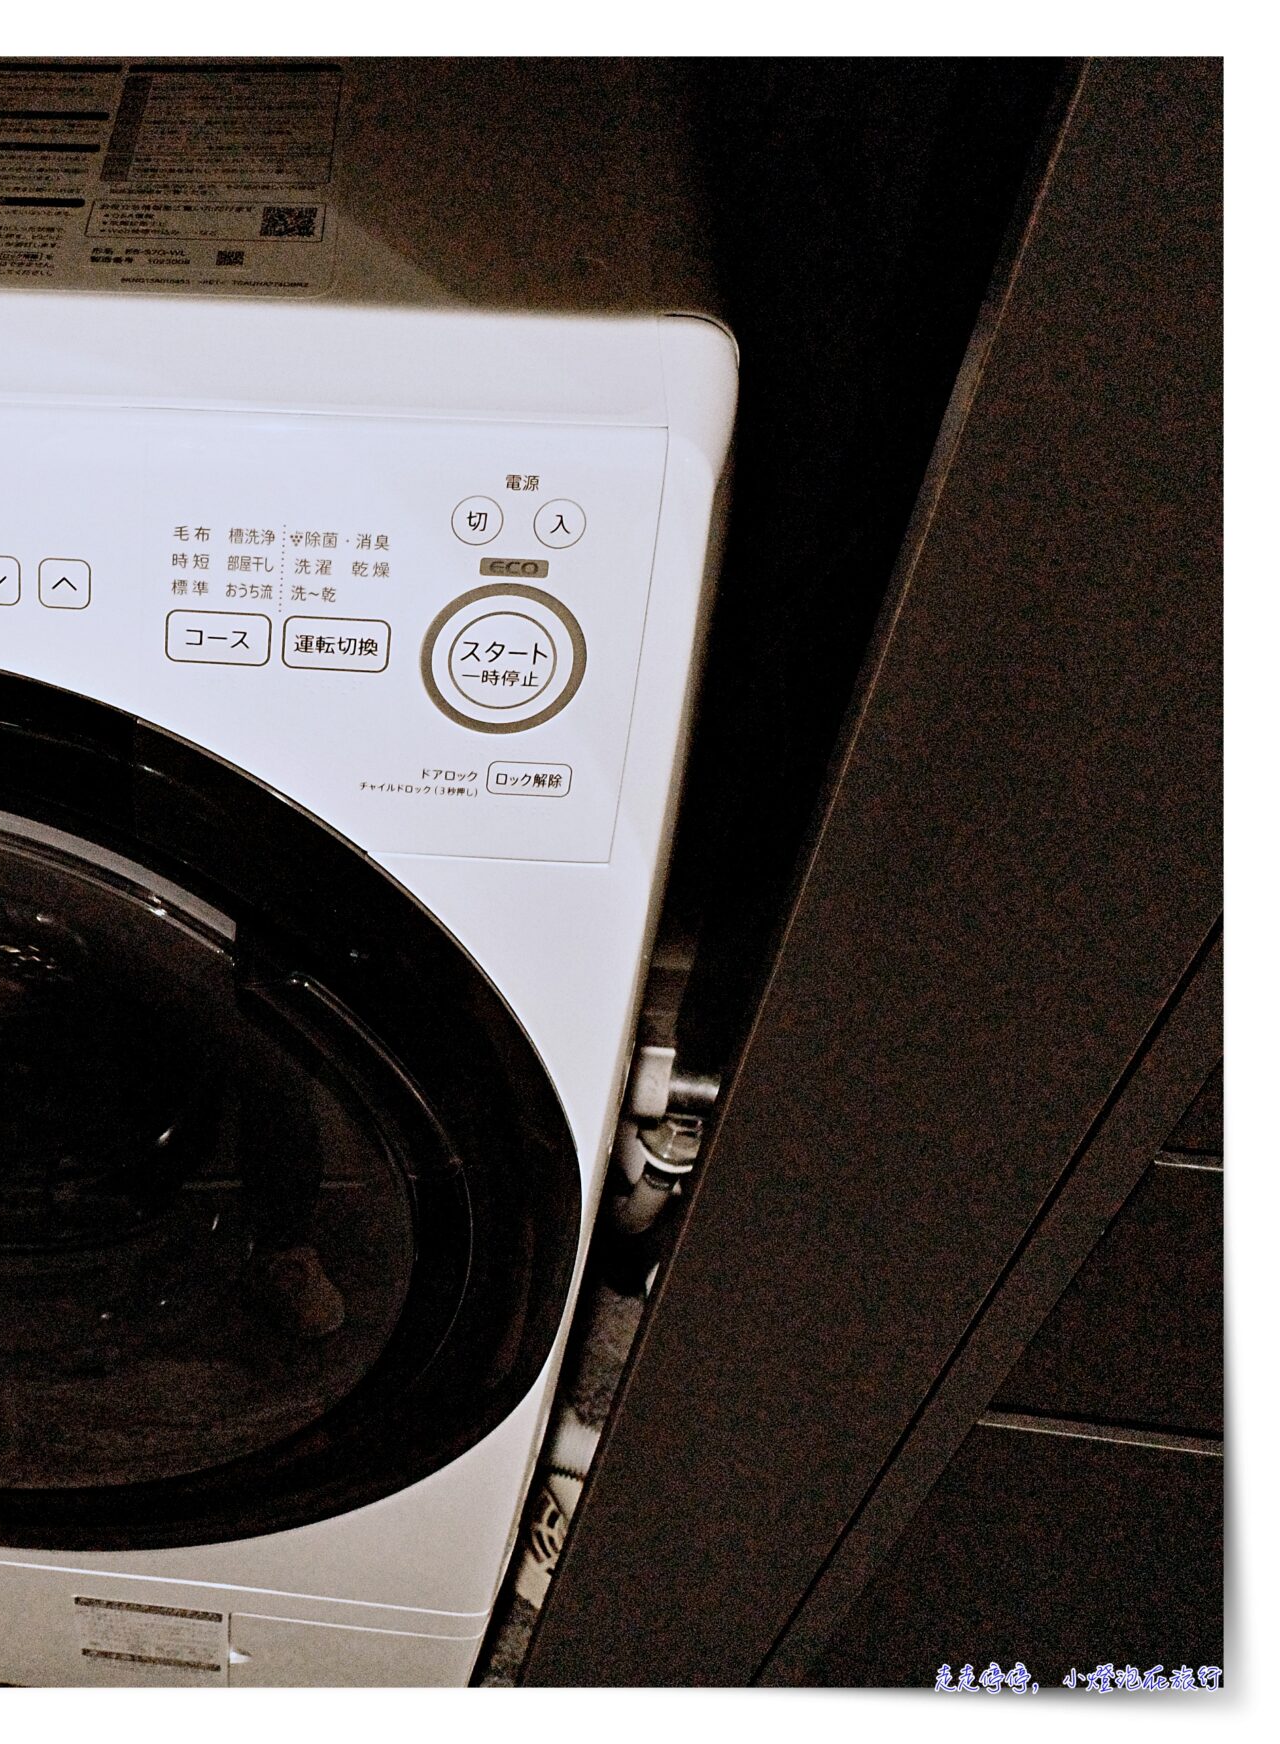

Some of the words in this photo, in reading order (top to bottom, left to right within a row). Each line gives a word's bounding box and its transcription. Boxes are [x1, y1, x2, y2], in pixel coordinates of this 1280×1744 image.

[505, 474, 540, 492] 電源
[466, 510, 489, 532] 切
[549, 514, 572, 535] 入
[228, 527, 276, 546] 槽洗浄
[227, 554, 275, 573] 部屋干し
[489, 561, 539, 575] ECO
[225, 582, 273, 600] おうち流
[184, 628, 250, 650] コース
[293, 634, 379, 657] 運転切換
[459, 640, 549, 666] スタート
[461, 669, 540, 688] 一時停止
[421, 768, 478, 783] ドアロック
[495, 772, 563, 789] ロック解除
